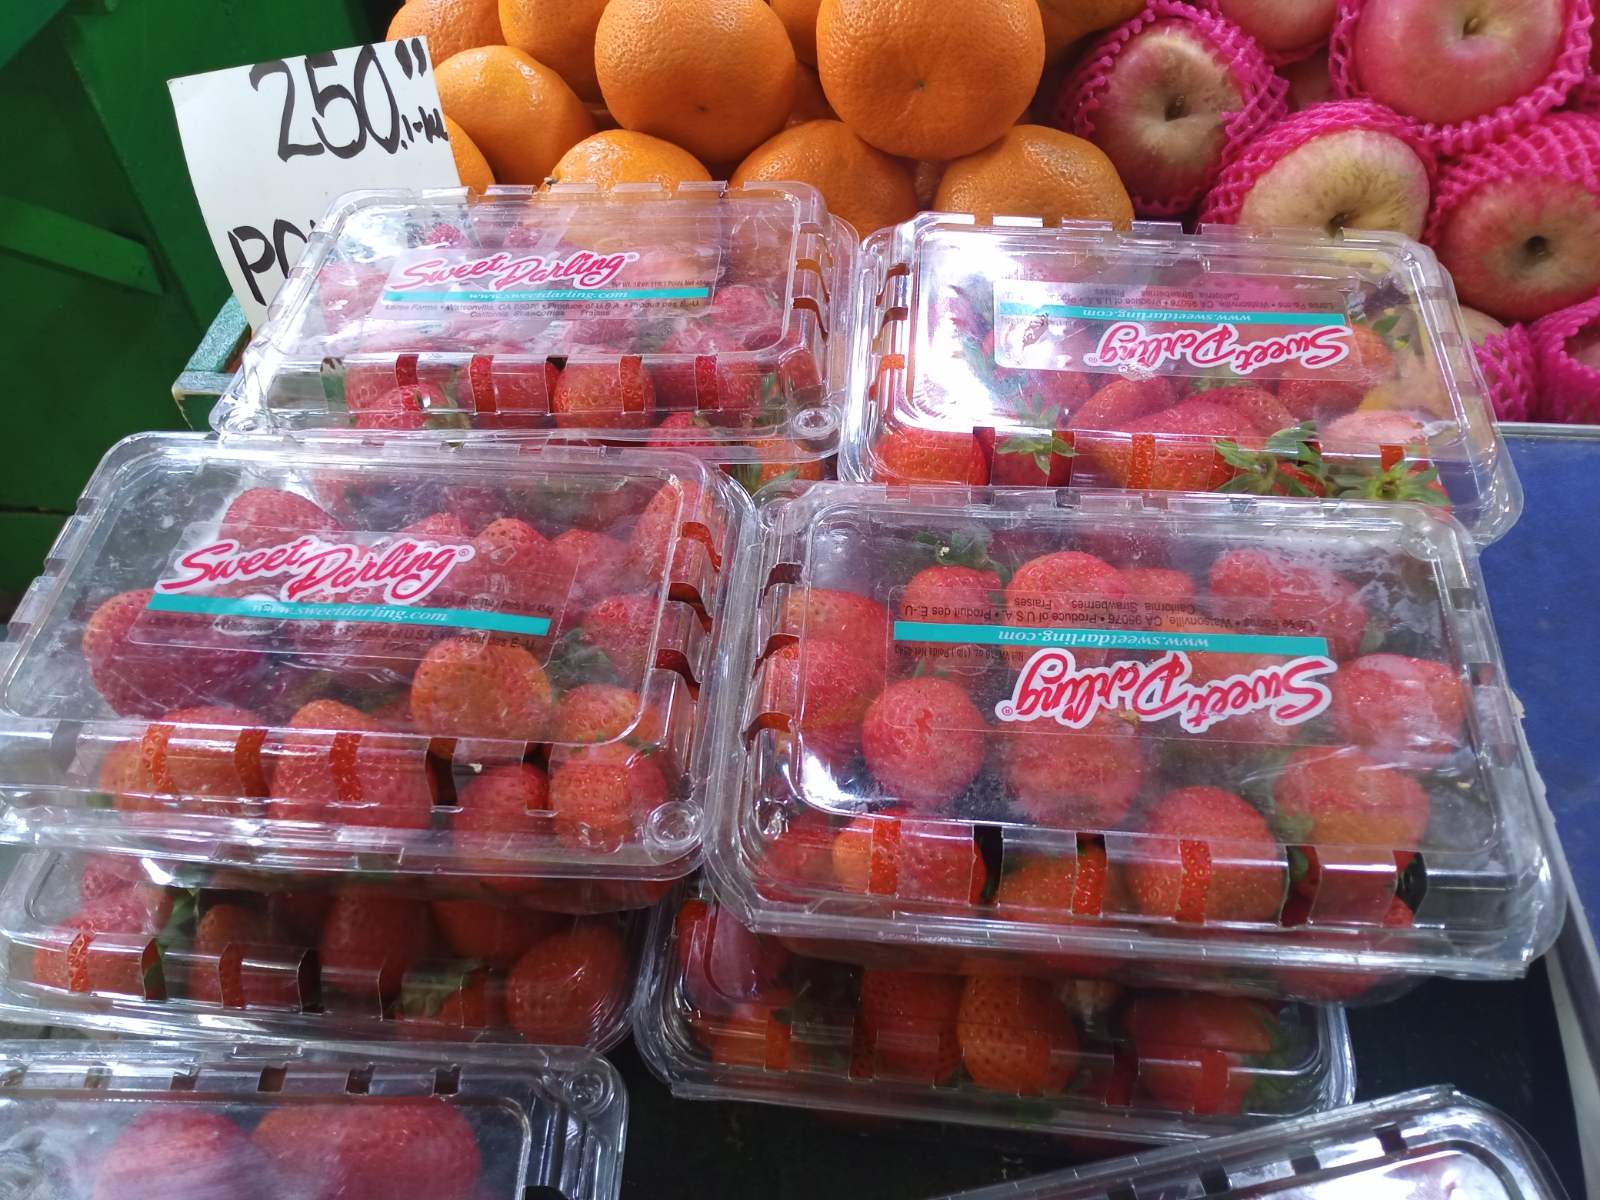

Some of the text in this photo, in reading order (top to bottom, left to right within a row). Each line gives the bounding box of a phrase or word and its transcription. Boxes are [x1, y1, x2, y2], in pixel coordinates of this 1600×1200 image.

[391, 252, 626, 290] Sweet Darling
[468, 289, 629, 301] www.sweetdarling.com
[1083, 309, 1252, 322] www.sweetdarling.com
[1099, 324, 1346, 371] Sweet Darling
[160, 538, 456, 601] Sweet Darling
[952, 607, 993, 621] Produit
[1013, 597, 1196, 615] California Strawberries Fraises
[1038, 610, 1050, 623] of
[1051, 611, 1098, 625] Produce
[1145, 615, 1164, 628] CA
[998, 630, 1210, 650] www.sweetdarling.com
[1014, 652, 1330, 729] Sweet Darling
